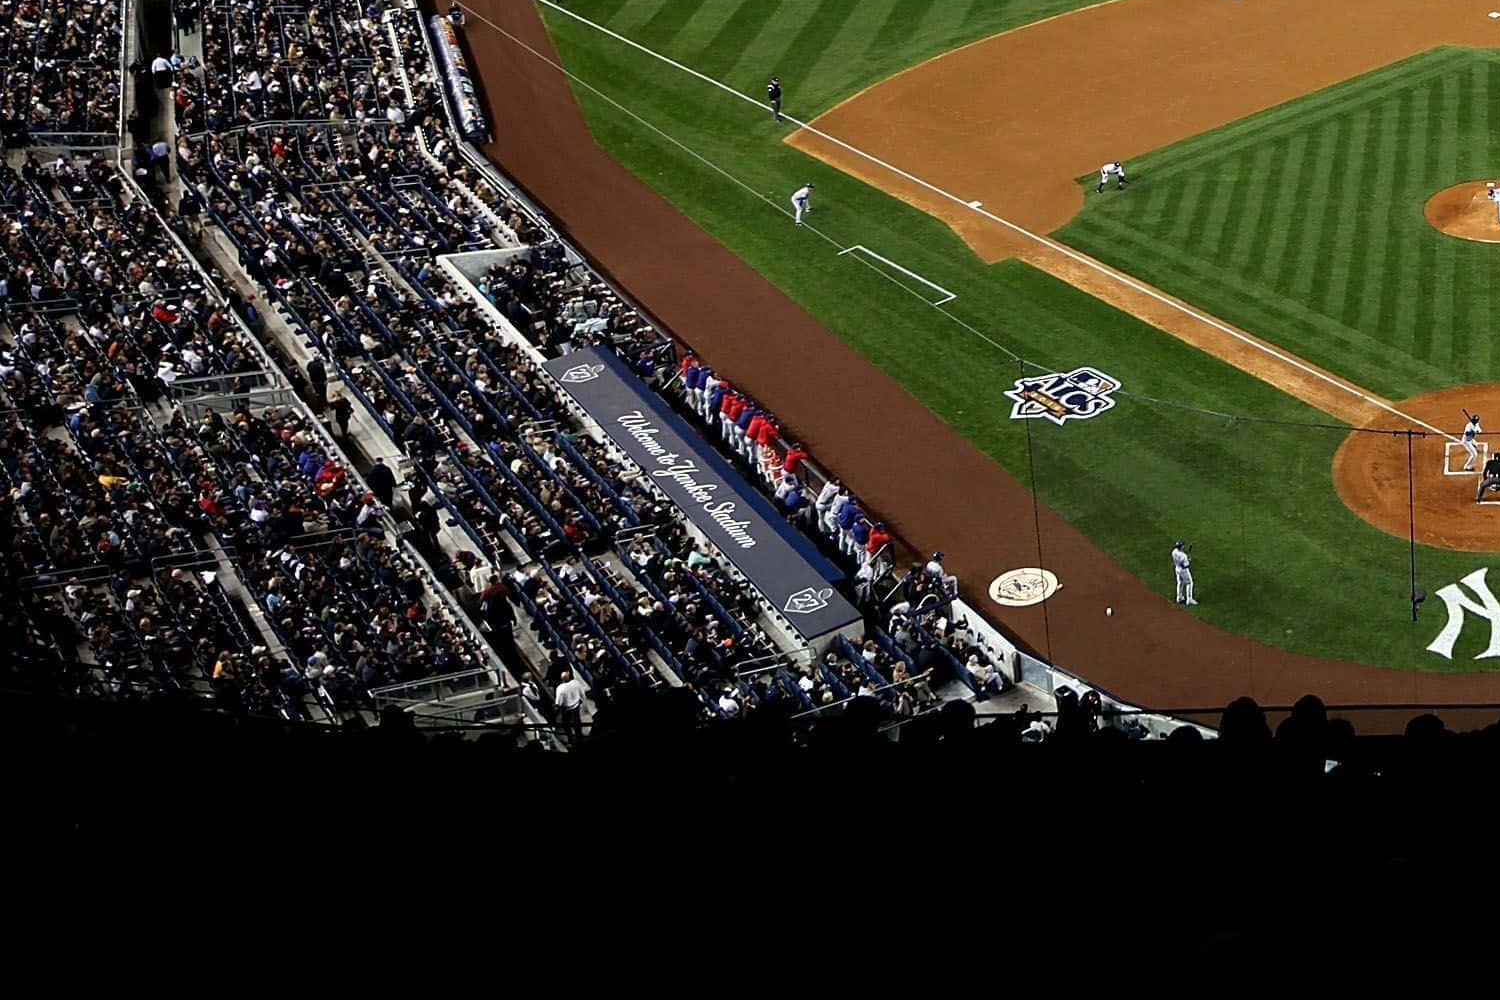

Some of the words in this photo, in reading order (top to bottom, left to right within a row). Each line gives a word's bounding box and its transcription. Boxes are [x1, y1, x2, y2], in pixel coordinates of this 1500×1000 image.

[617, 410, 662, 459] Welcome
[653, 458, 718, 504] Yankee
[657, 451, 674, 466] to
[702, 500, 759, 550] Stadium
